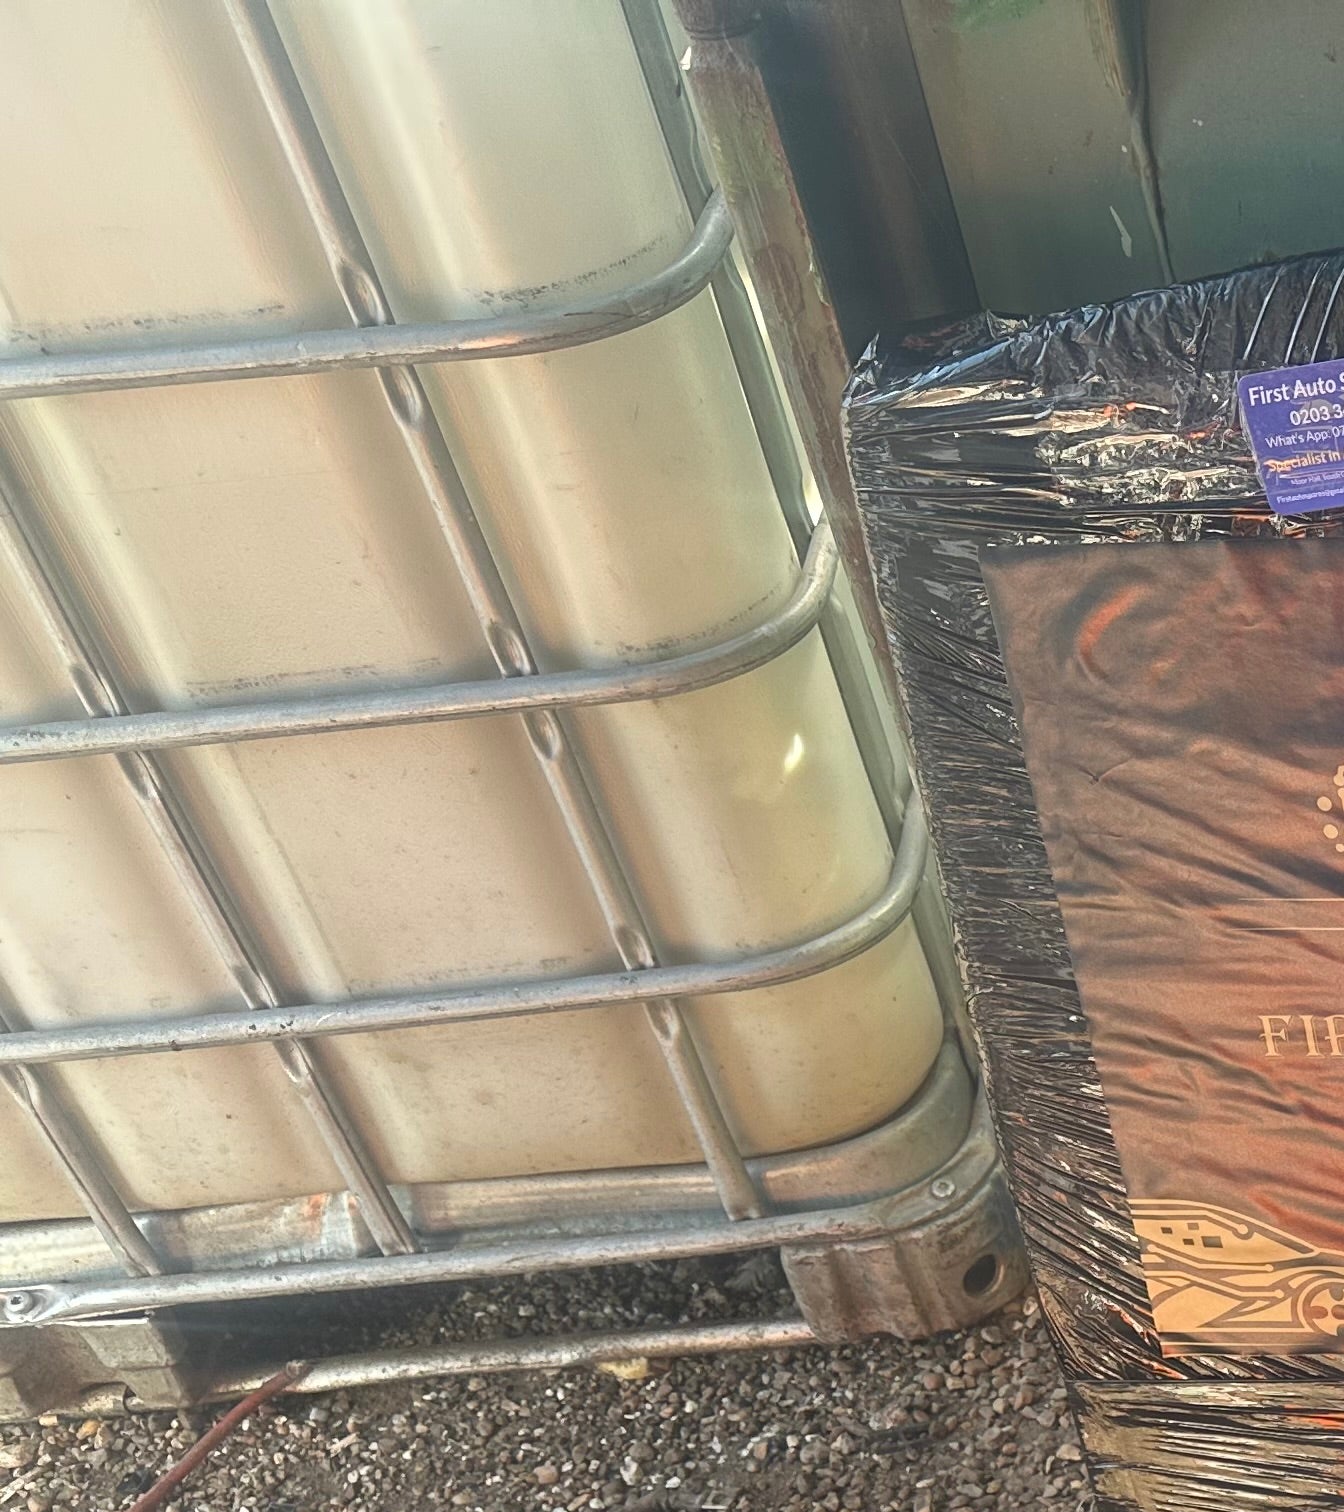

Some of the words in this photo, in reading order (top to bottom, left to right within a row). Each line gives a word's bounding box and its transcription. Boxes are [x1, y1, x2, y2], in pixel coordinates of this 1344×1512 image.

[1248, 383, 1290, 407] First
[1293, 377, 1337, 400] Auto
[1290, 402, 1331, 426] 0203
[1265, 430, 1304, 449] What's
[1329, 448, 1341, 462] in
